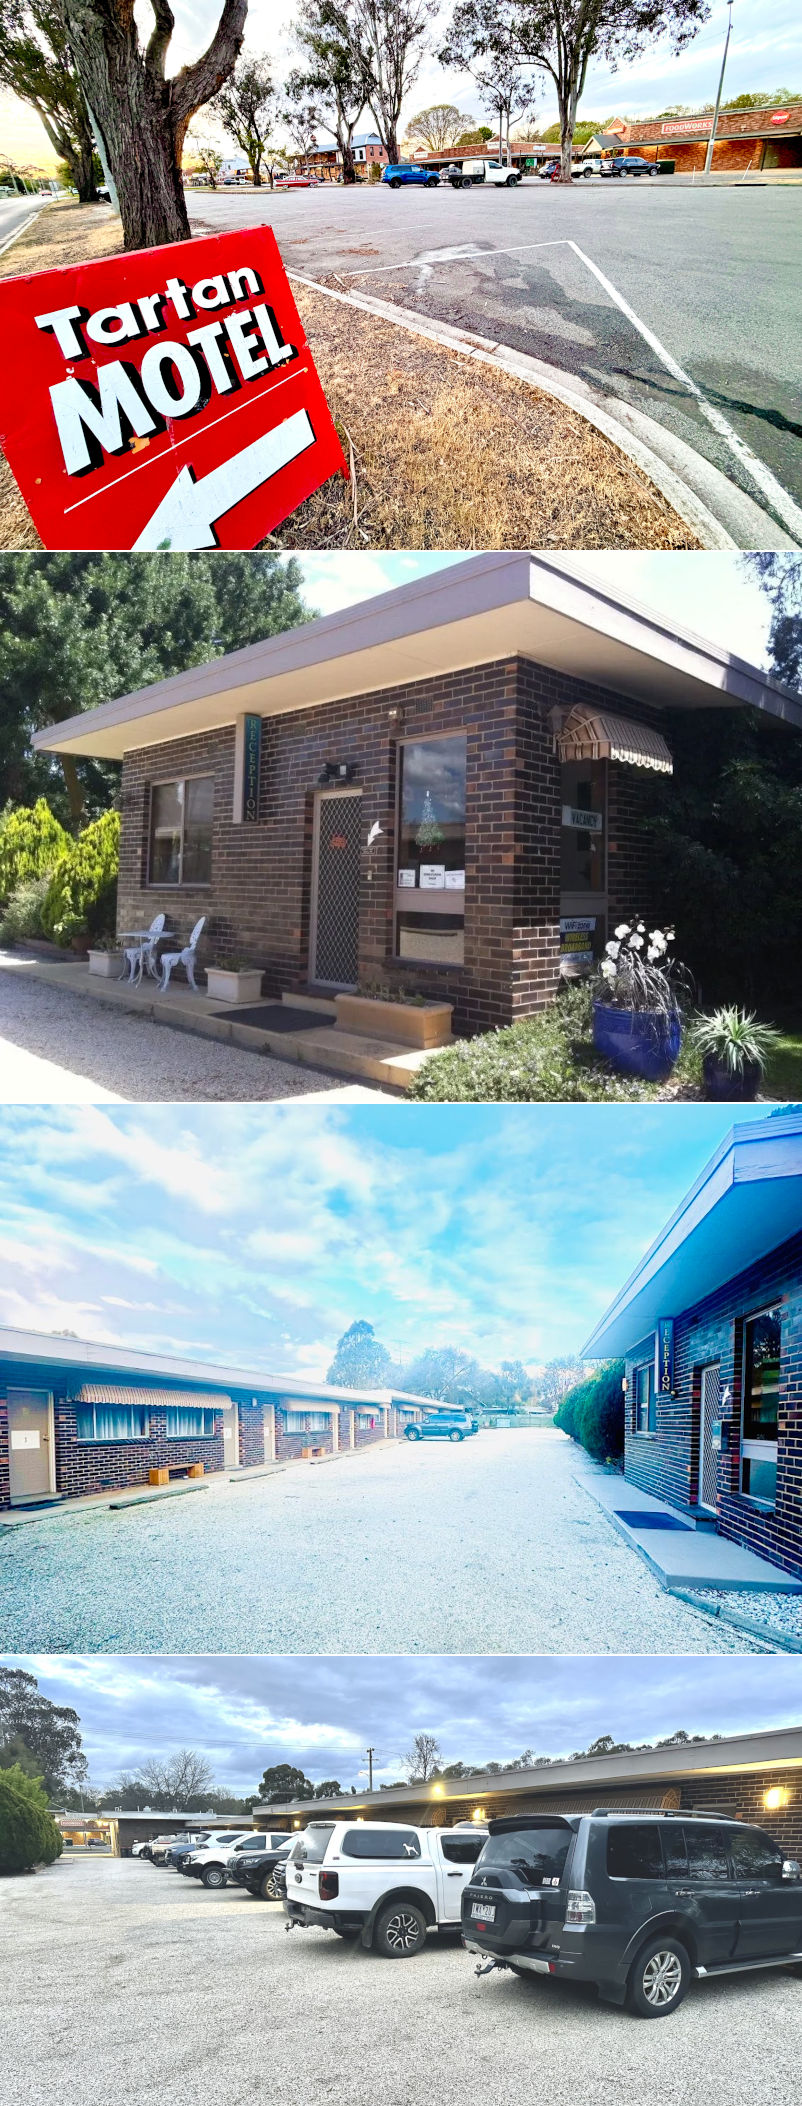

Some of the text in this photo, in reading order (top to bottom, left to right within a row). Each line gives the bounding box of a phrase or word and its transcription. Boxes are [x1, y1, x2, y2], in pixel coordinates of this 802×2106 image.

[34, 267, 264, 360] Tartan
[49, 304, 297, 476] MOTEL
[246, 719, 257, 820] RECEPTION
[662, 1322, 670, 1390] RECEPTION
